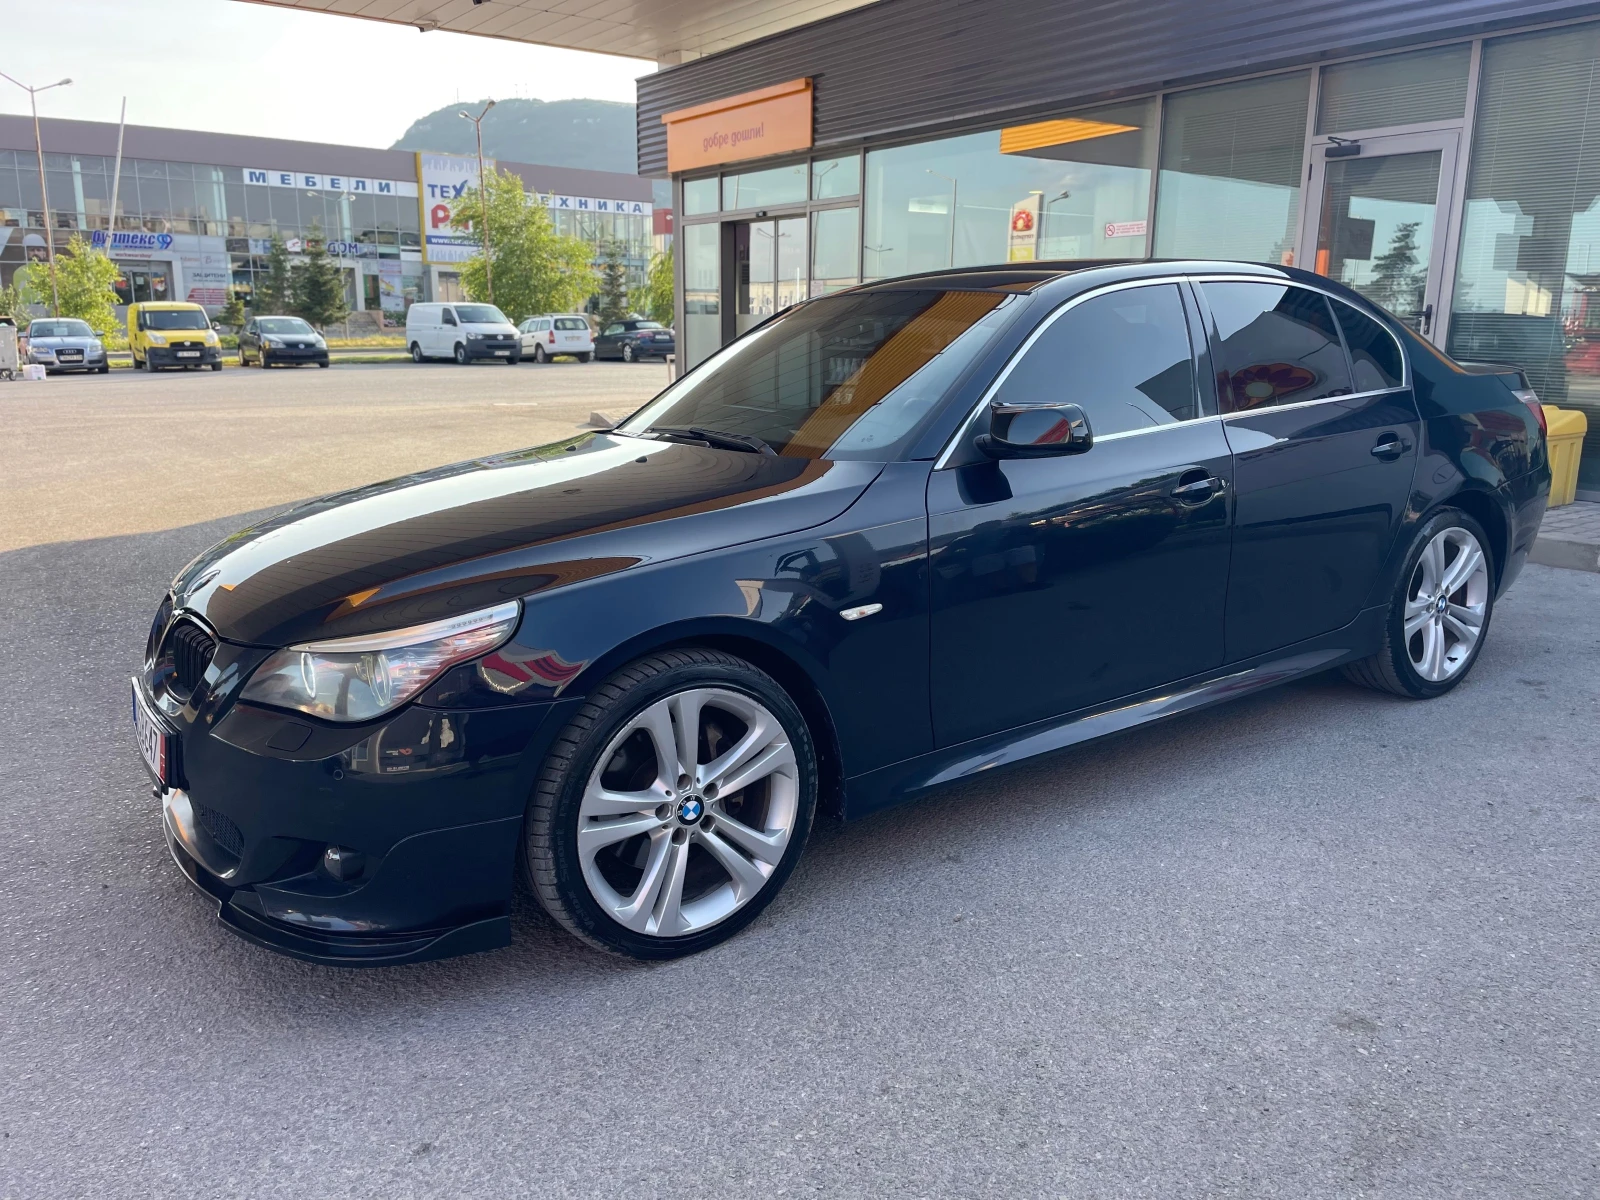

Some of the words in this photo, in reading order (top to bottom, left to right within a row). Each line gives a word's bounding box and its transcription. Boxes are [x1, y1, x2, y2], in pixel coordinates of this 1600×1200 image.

[703, 132, 729, 152] добре
[731, 122, 764, 147] дошли!
[249, 171, 391, 193] МЕБЕЛИ
